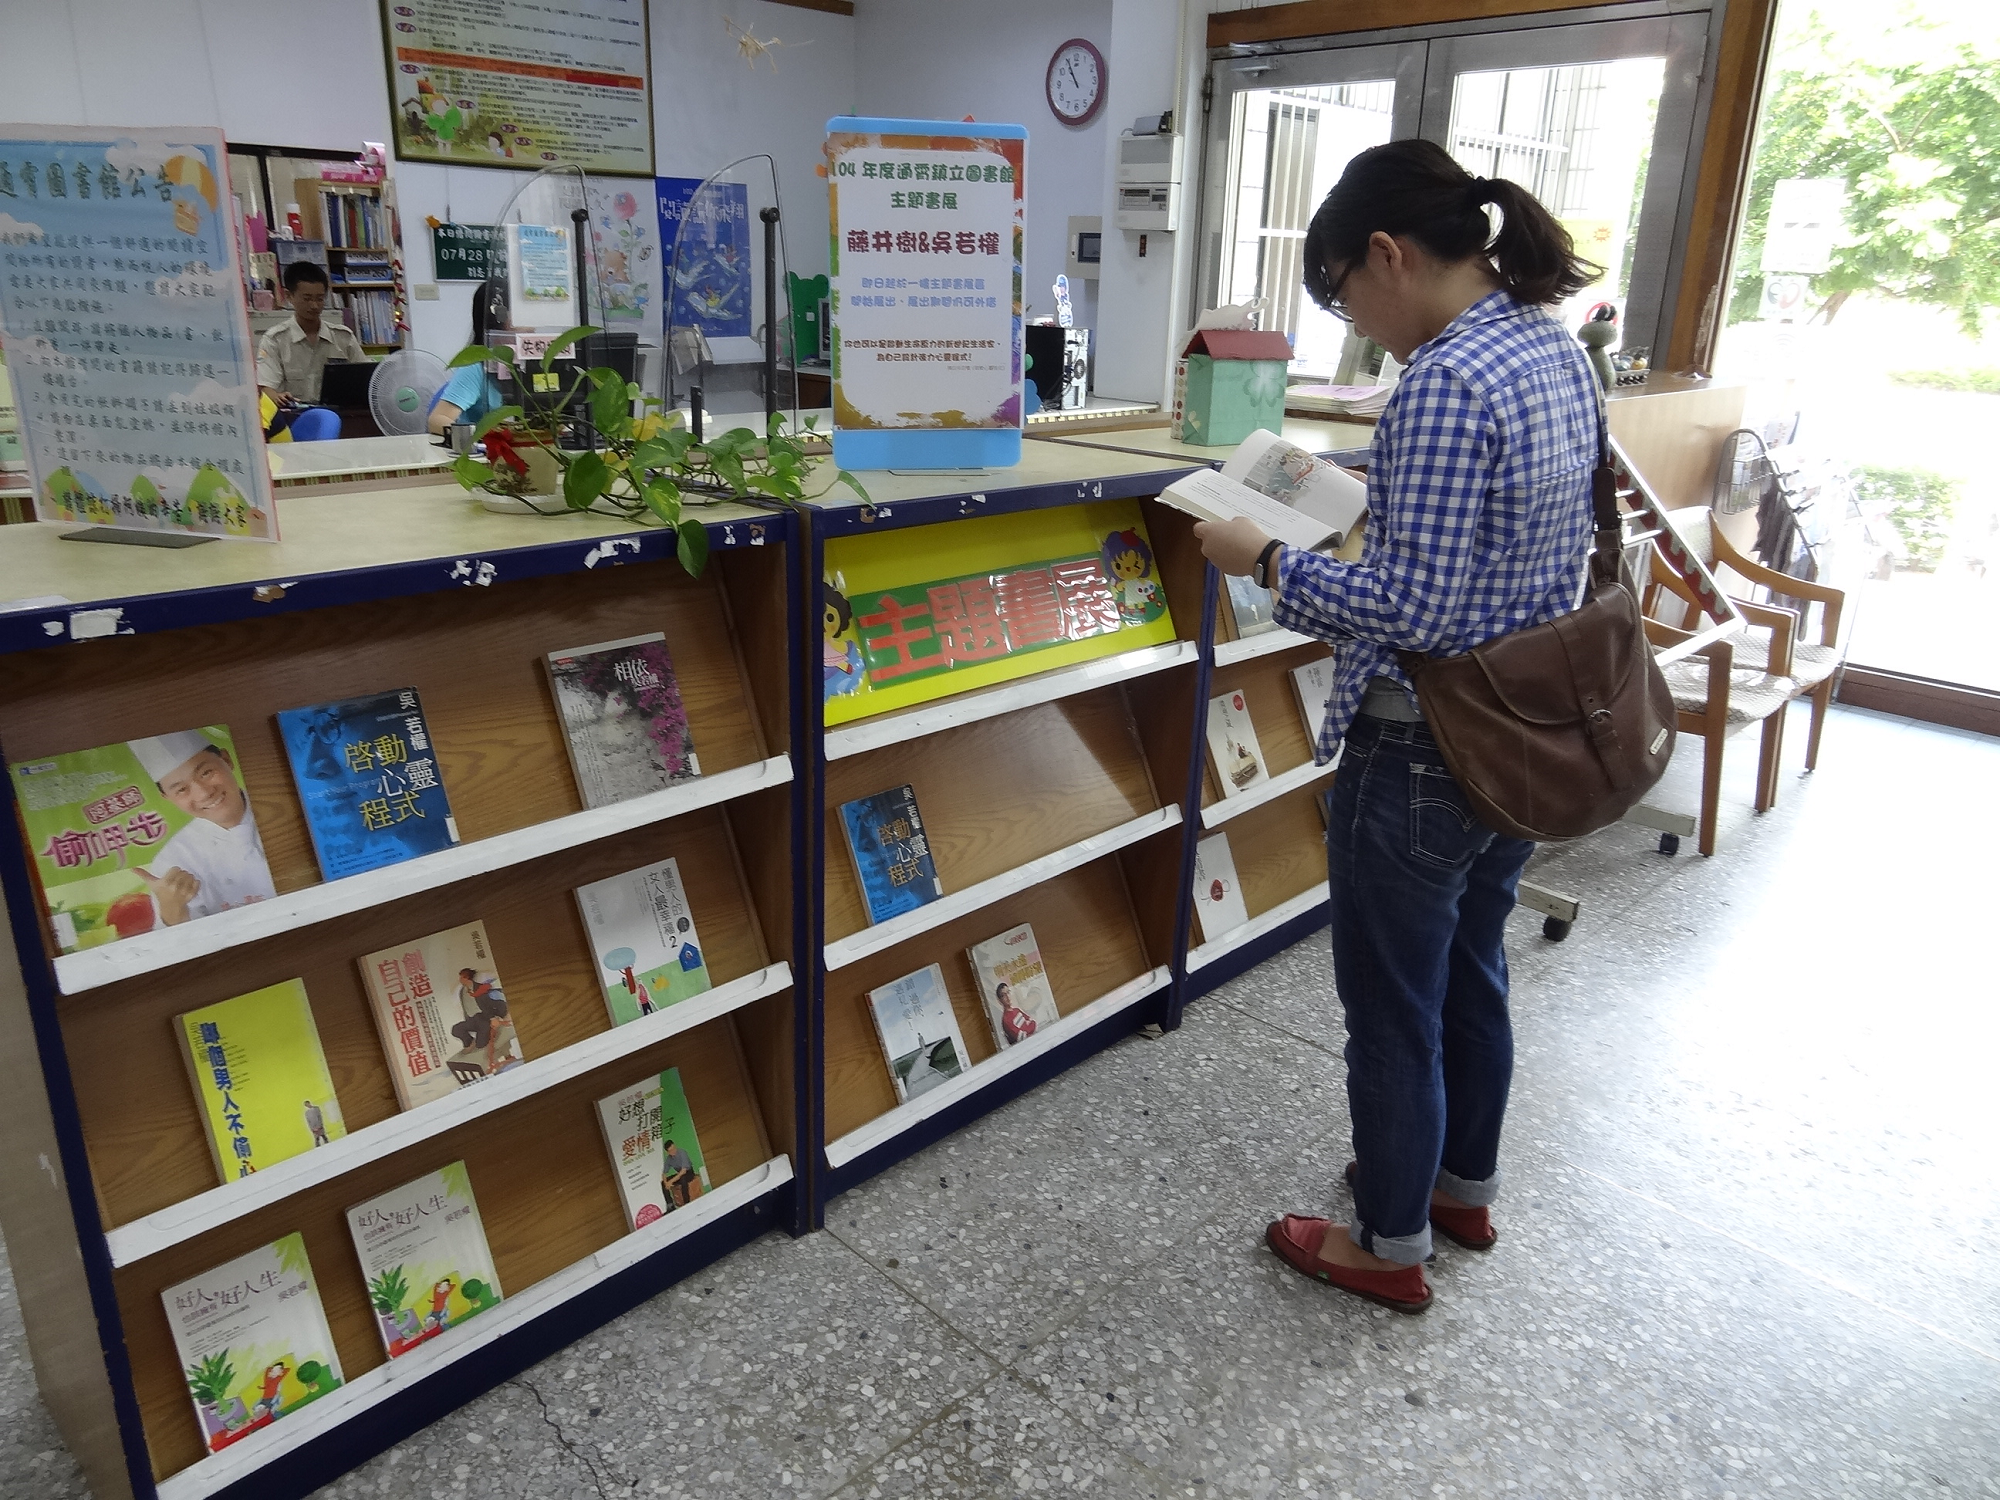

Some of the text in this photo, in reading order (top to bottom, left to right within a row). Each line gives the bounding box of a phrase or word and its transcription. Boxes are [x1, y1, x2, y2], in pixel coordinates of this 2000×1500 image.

[891, 190, 959, 210] 主題書展
[847, 229, 1000, 256] 藤井樹&吳若權
[857, 557, 1121, 683] 主題書展
[613, 657, 650, 682] 相依
[377, 757, 439, 797] 心靈
[358, 790, 426, 832] 程式
[887, 857, 924, 888] 程式
